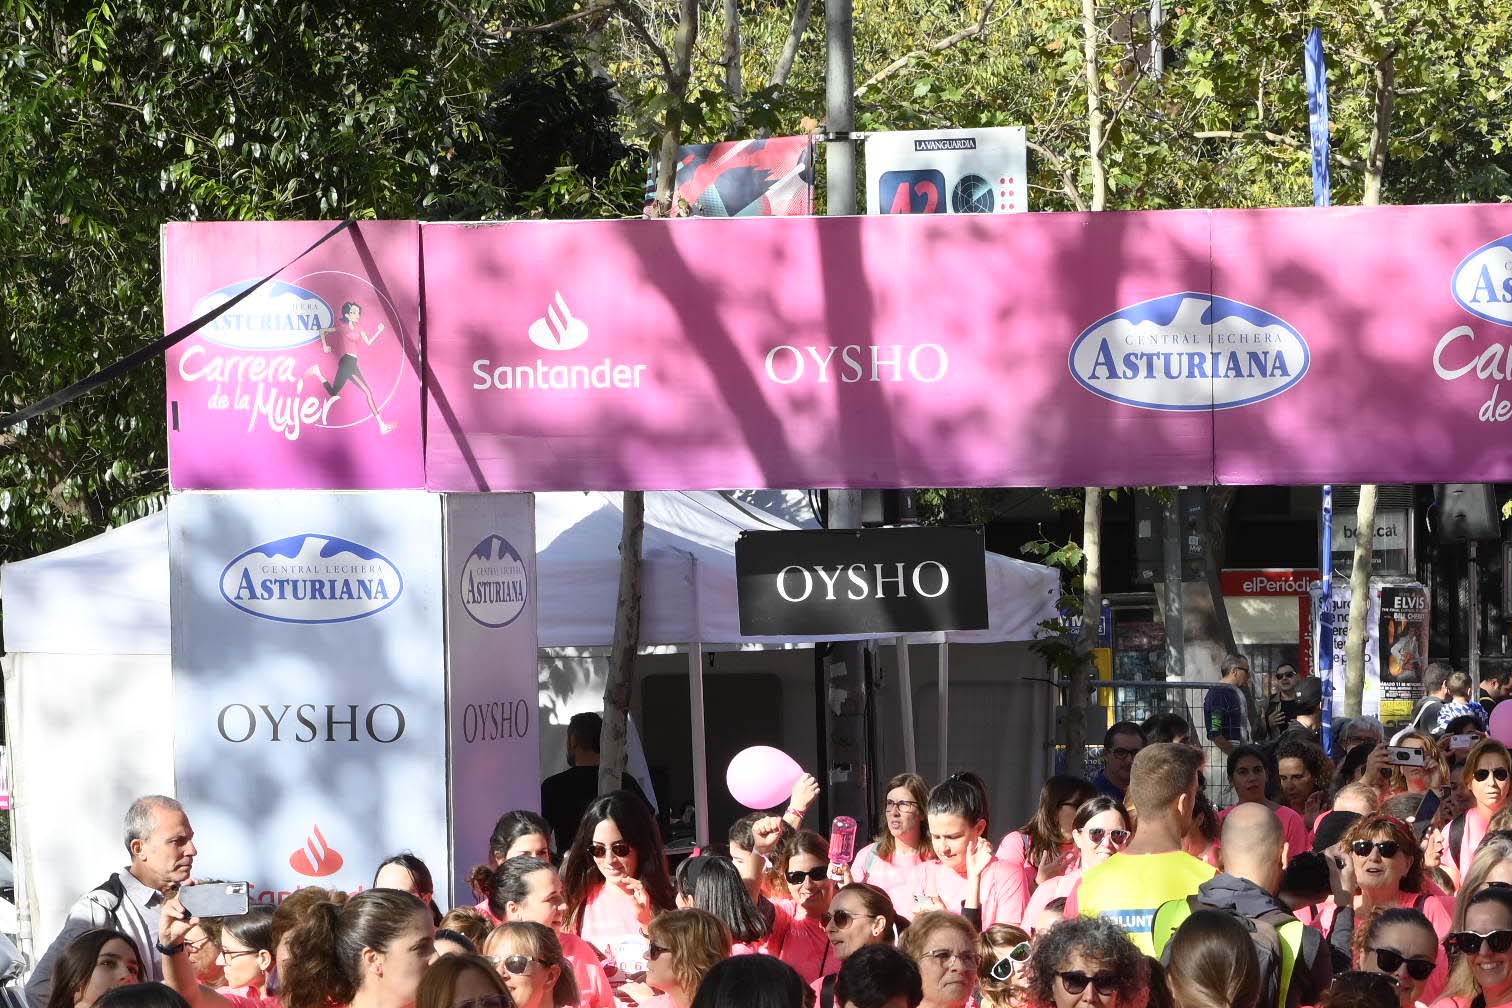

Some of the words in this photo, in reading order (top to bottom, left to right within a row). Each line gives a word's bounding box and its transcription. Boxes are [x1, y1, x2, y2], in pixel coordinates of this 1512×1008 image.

[1087, 336, 1292, 381] ASTURIANA
[1125, 333, 1200, 345] CENTRAL
[179, 344, 297, 383] Carrera
[472, 360, 647, 390] Santander
[764, 344, 949, 384] OYSHO
[208, 389, 232, 409] de
[234, 389, 251, 410] la
[248, 378, 341, 441] Mujer
[1478, 383, 1512, 422] de
[233, 567, 390, 602] ASTURIANA
[261, 564, 320, 575] CENTRAL
[325, 564, 385, 575] LECHERA
[465, 569, 524, 606] ASTURIANA
[775, 560, 950, 603] OYSHO
[1394, 596, 1425, 609] ELVIS
[216, 703, 407, 743] OYSHO
[463, 699, 529, 744] OYSHO
